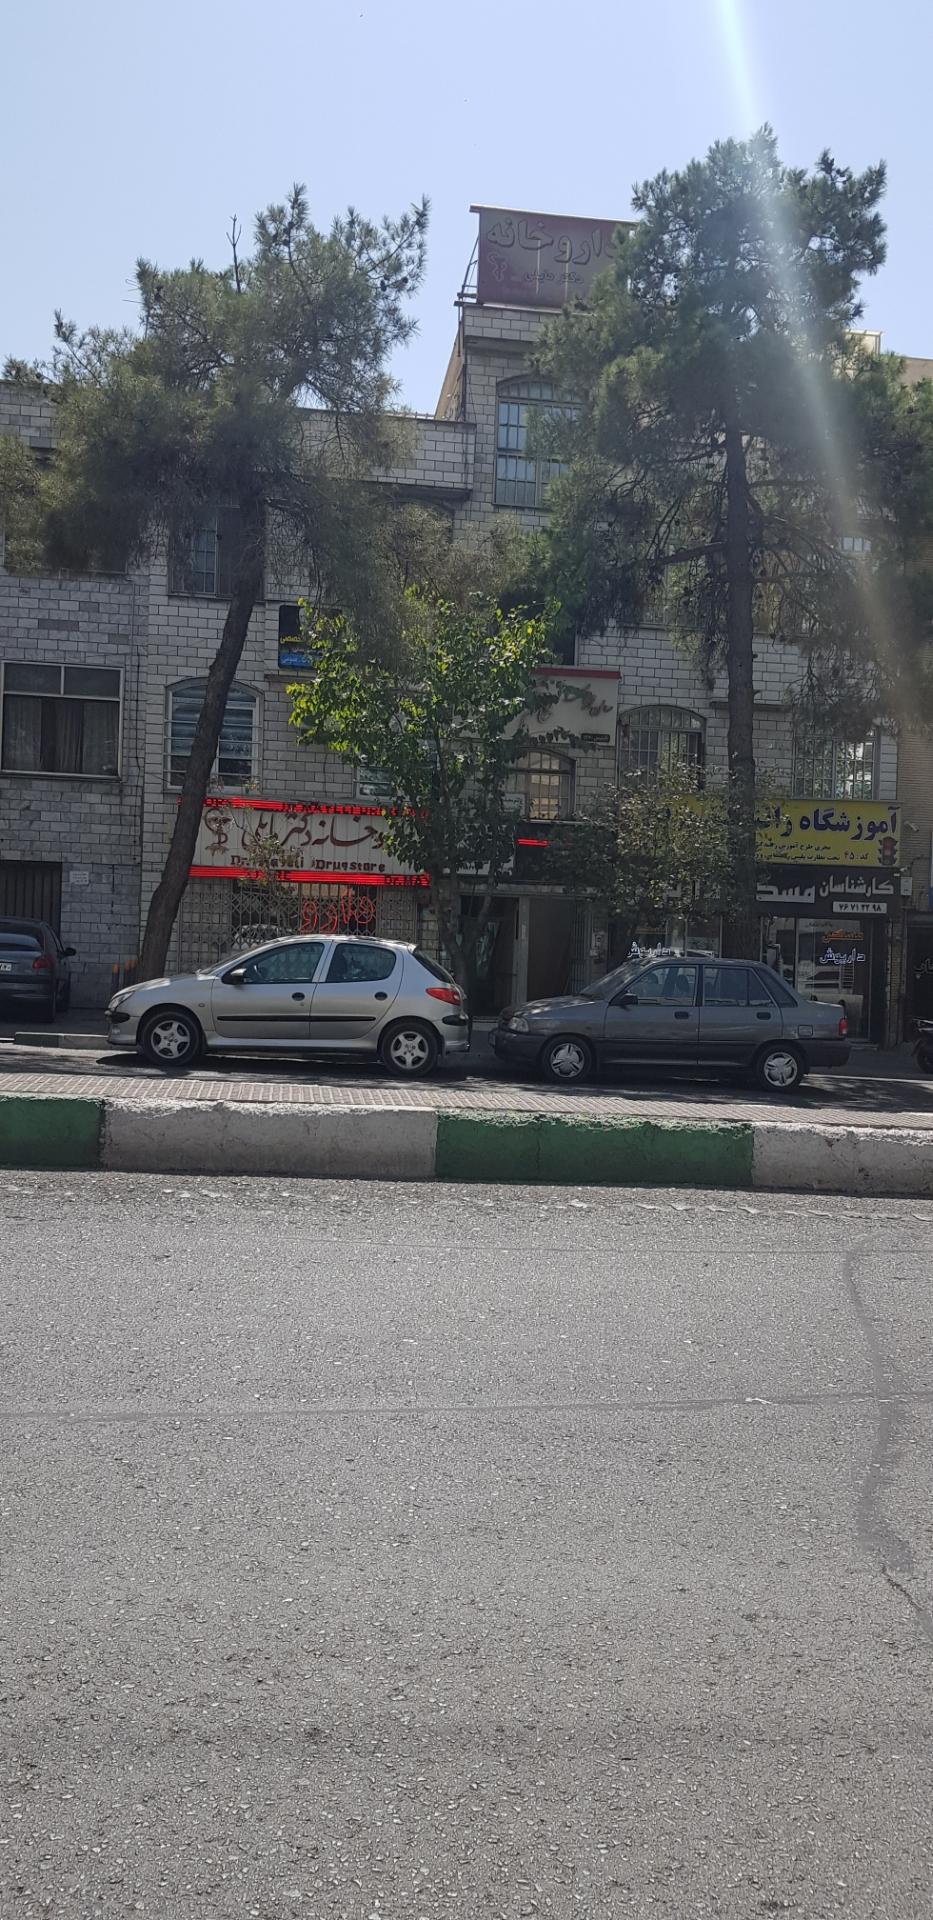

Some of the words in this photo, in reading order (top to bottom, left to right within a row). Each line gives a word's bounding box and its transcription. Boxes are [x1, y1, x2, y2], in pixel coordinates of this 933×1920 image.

[800, 806, 900, 841] آموزشگاه
[314, 858, 386, 873] Drugstore
[819, 874, 894, 897] کارشناسان
[819, 946, 866, 964] داریوش
